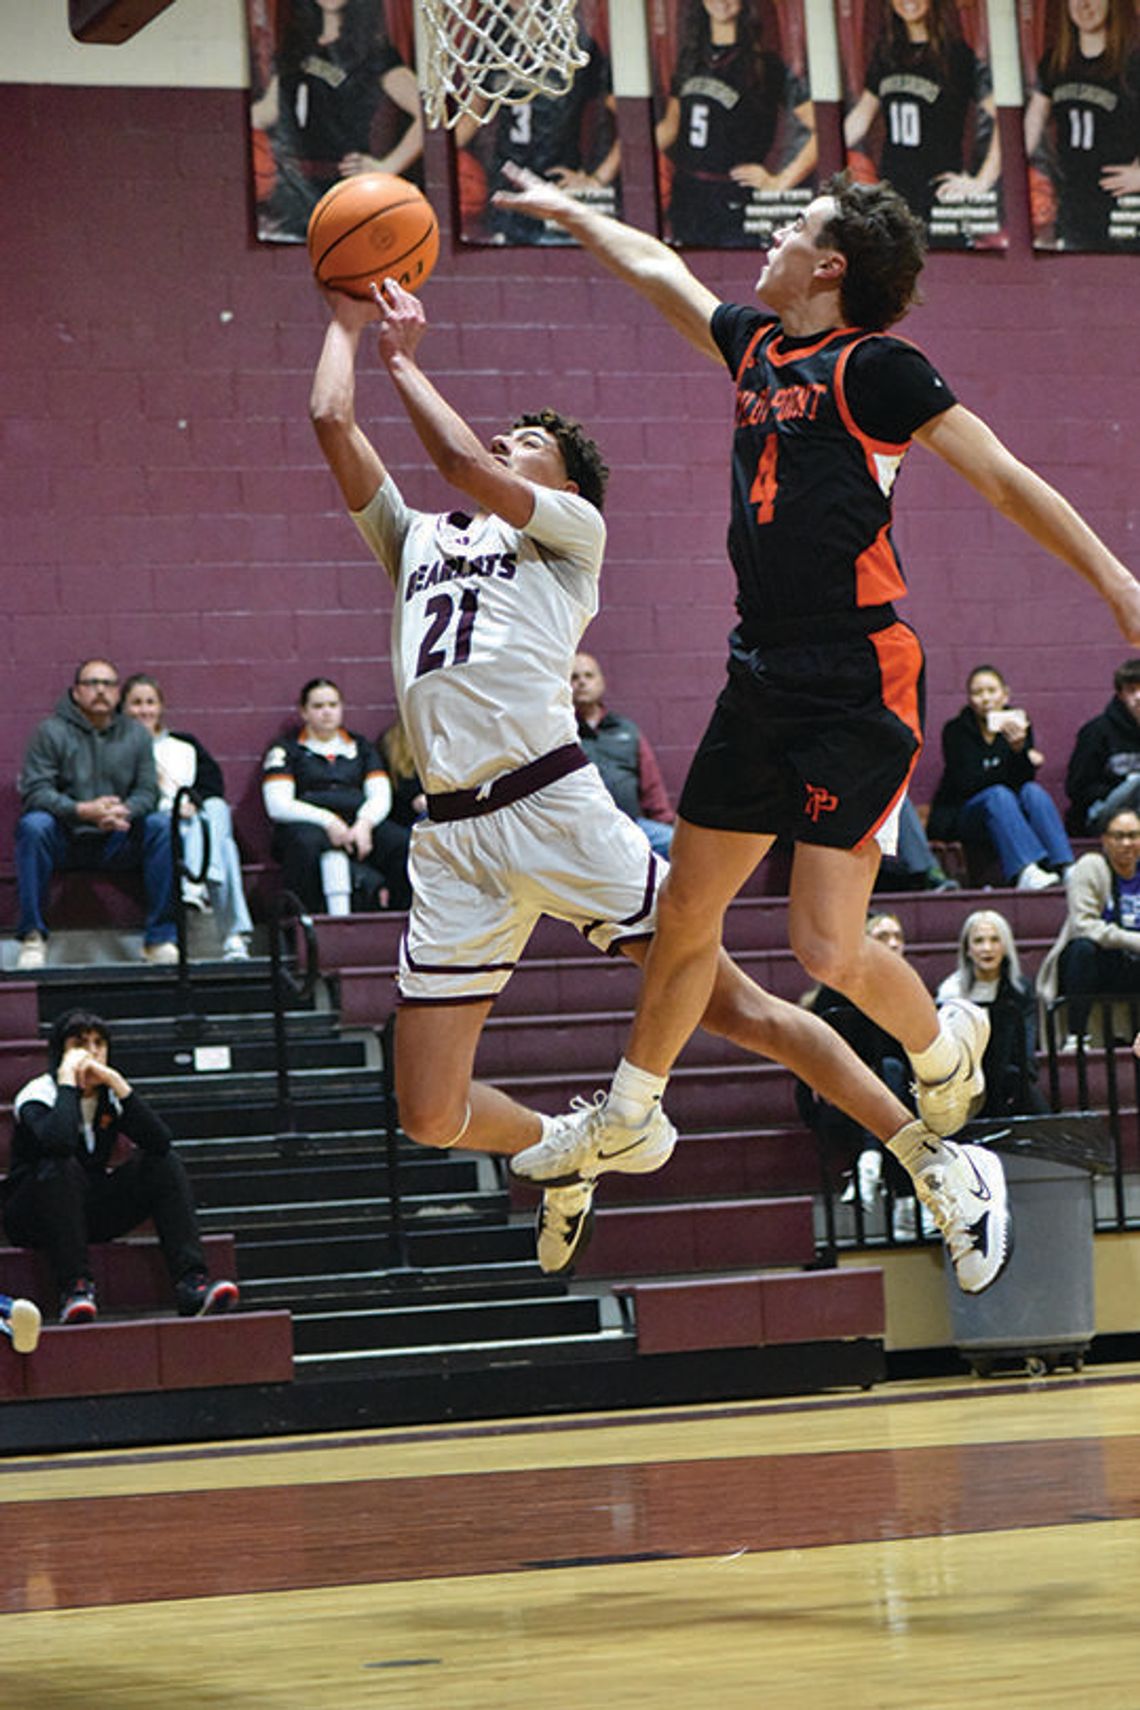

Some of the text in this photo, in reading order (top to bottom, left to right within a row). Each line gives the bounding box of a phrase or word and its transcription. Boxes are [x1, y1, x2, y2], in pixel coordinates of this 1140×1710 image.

[509, 103, 532, 145] 3
[689, 104, 710, 149] 5
[890, 101, 921, 147] 10
[1069, 108, 1095, 151] 11
[749, 433, 779, 525] 4
[415, 588, 480, 679] 21
